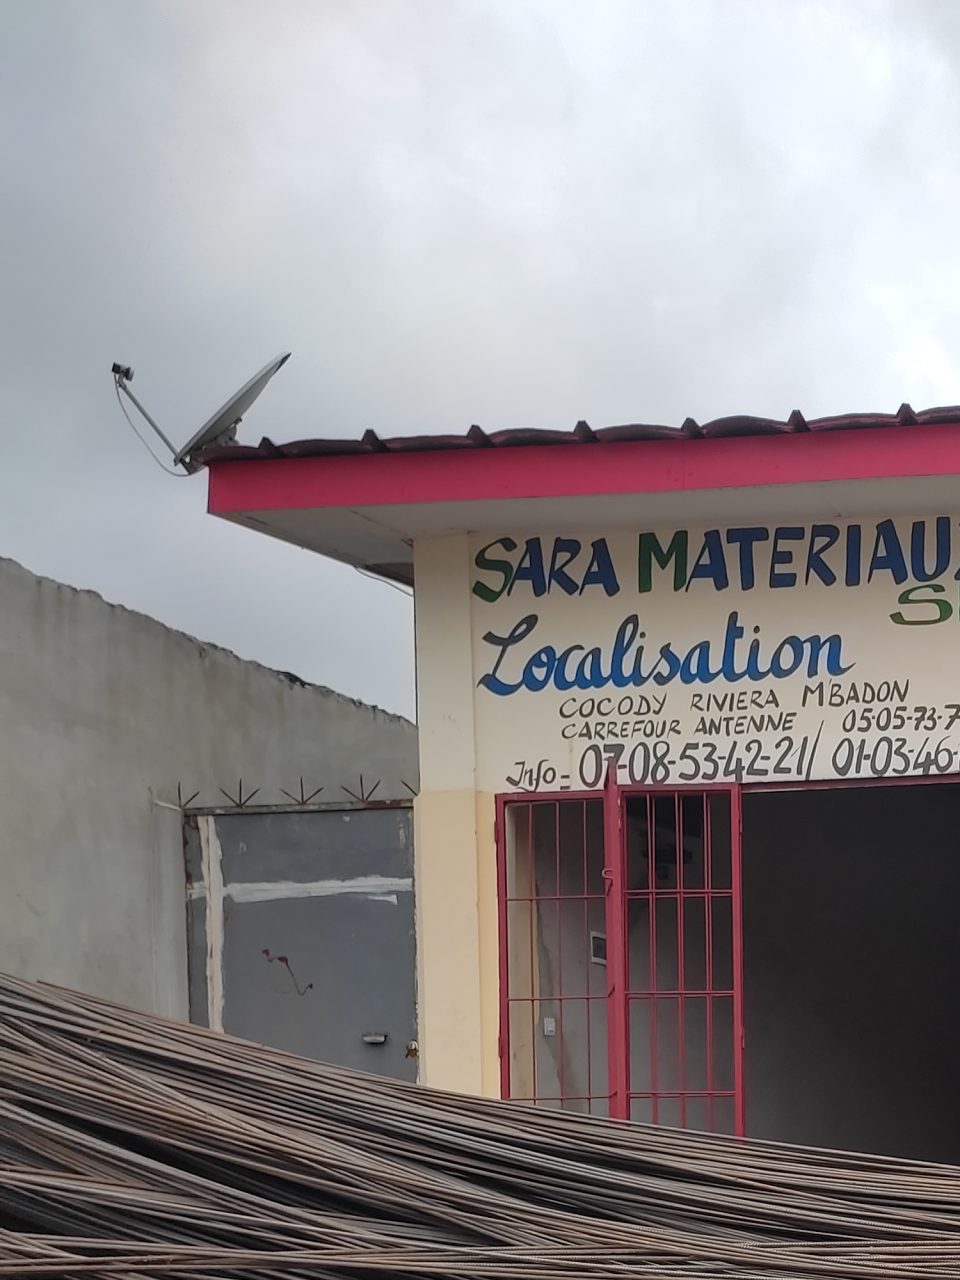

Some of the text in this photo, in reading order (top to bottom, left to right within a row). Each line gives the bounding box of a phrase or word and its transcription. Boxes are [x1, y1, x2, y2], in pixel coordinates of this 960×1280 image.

[472, 536, 620, 603] SARA
[476, 611, 856, 696] Localisation
[559, 692, 668, 719] COCODY
[690, 689, 780, 713] RIVIERA
[561, 711, 798, 740] CARREFOUR ANTENNE
